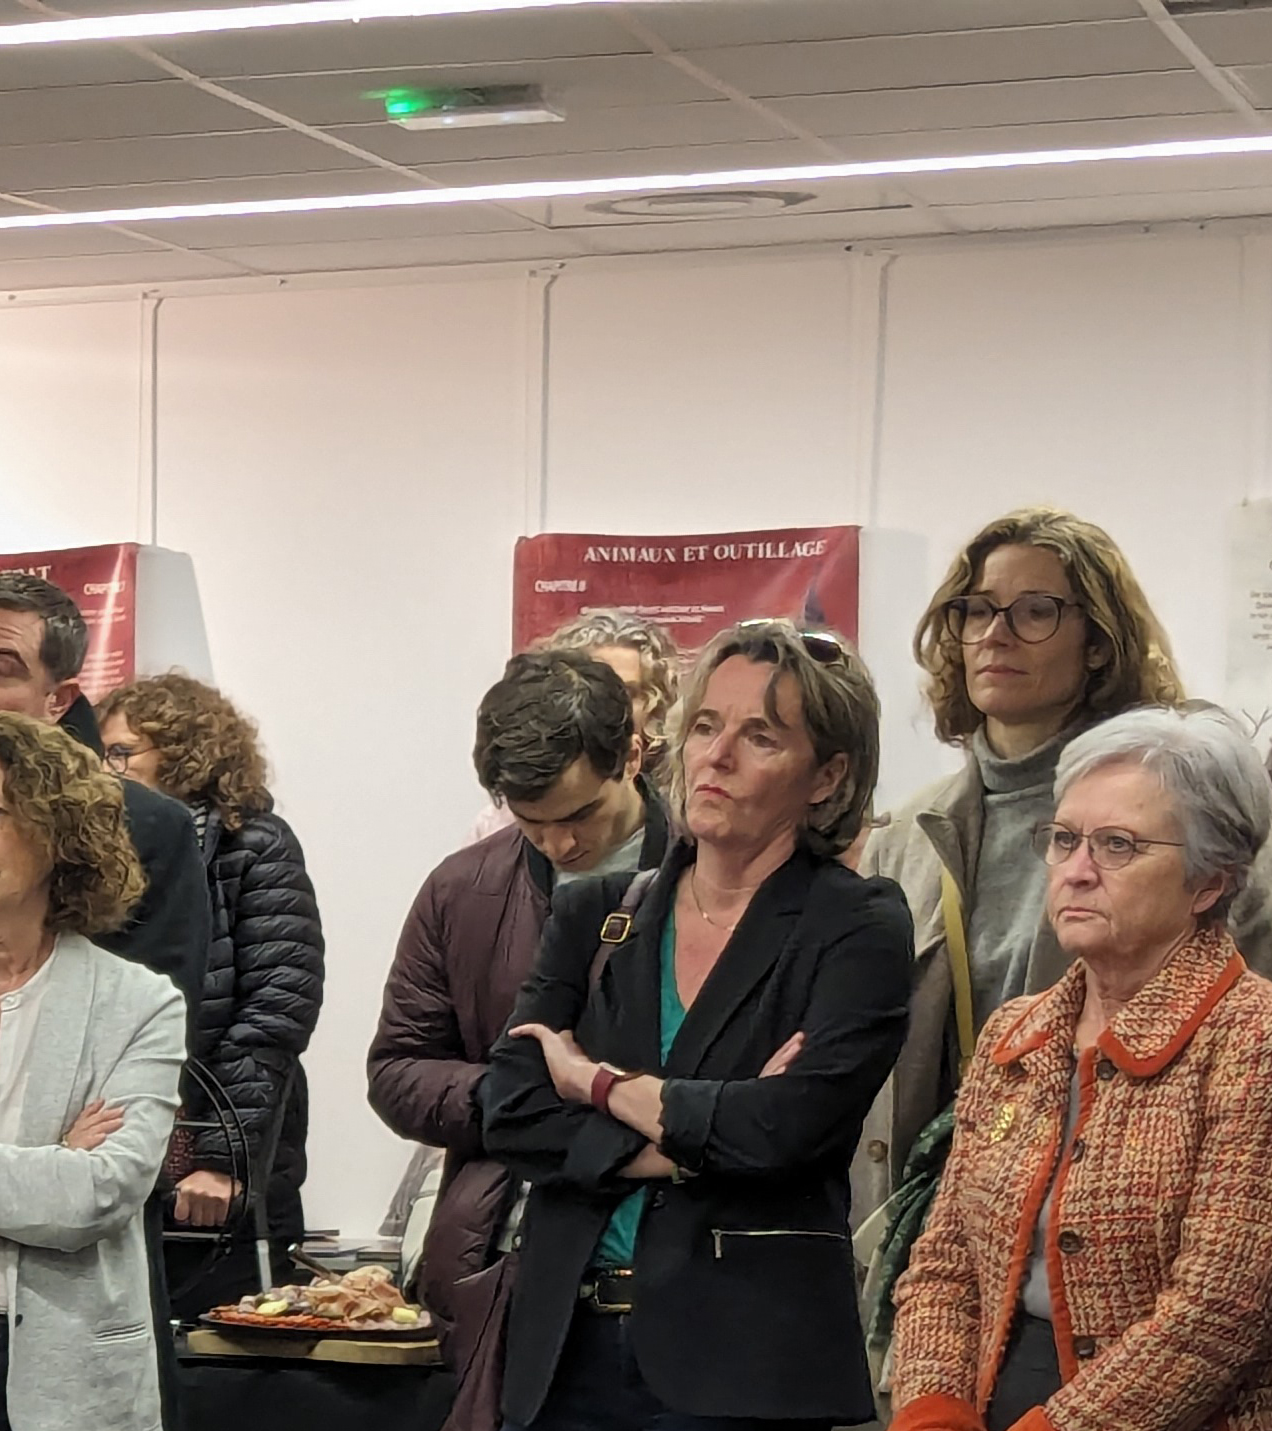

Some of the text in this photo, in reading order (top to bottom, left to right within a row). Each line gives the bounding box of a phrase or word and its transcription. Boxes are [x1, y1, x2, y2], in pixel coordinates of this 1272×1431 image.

[583, 539, 828, 563] ANIMAUX ET OUTILLAGE
